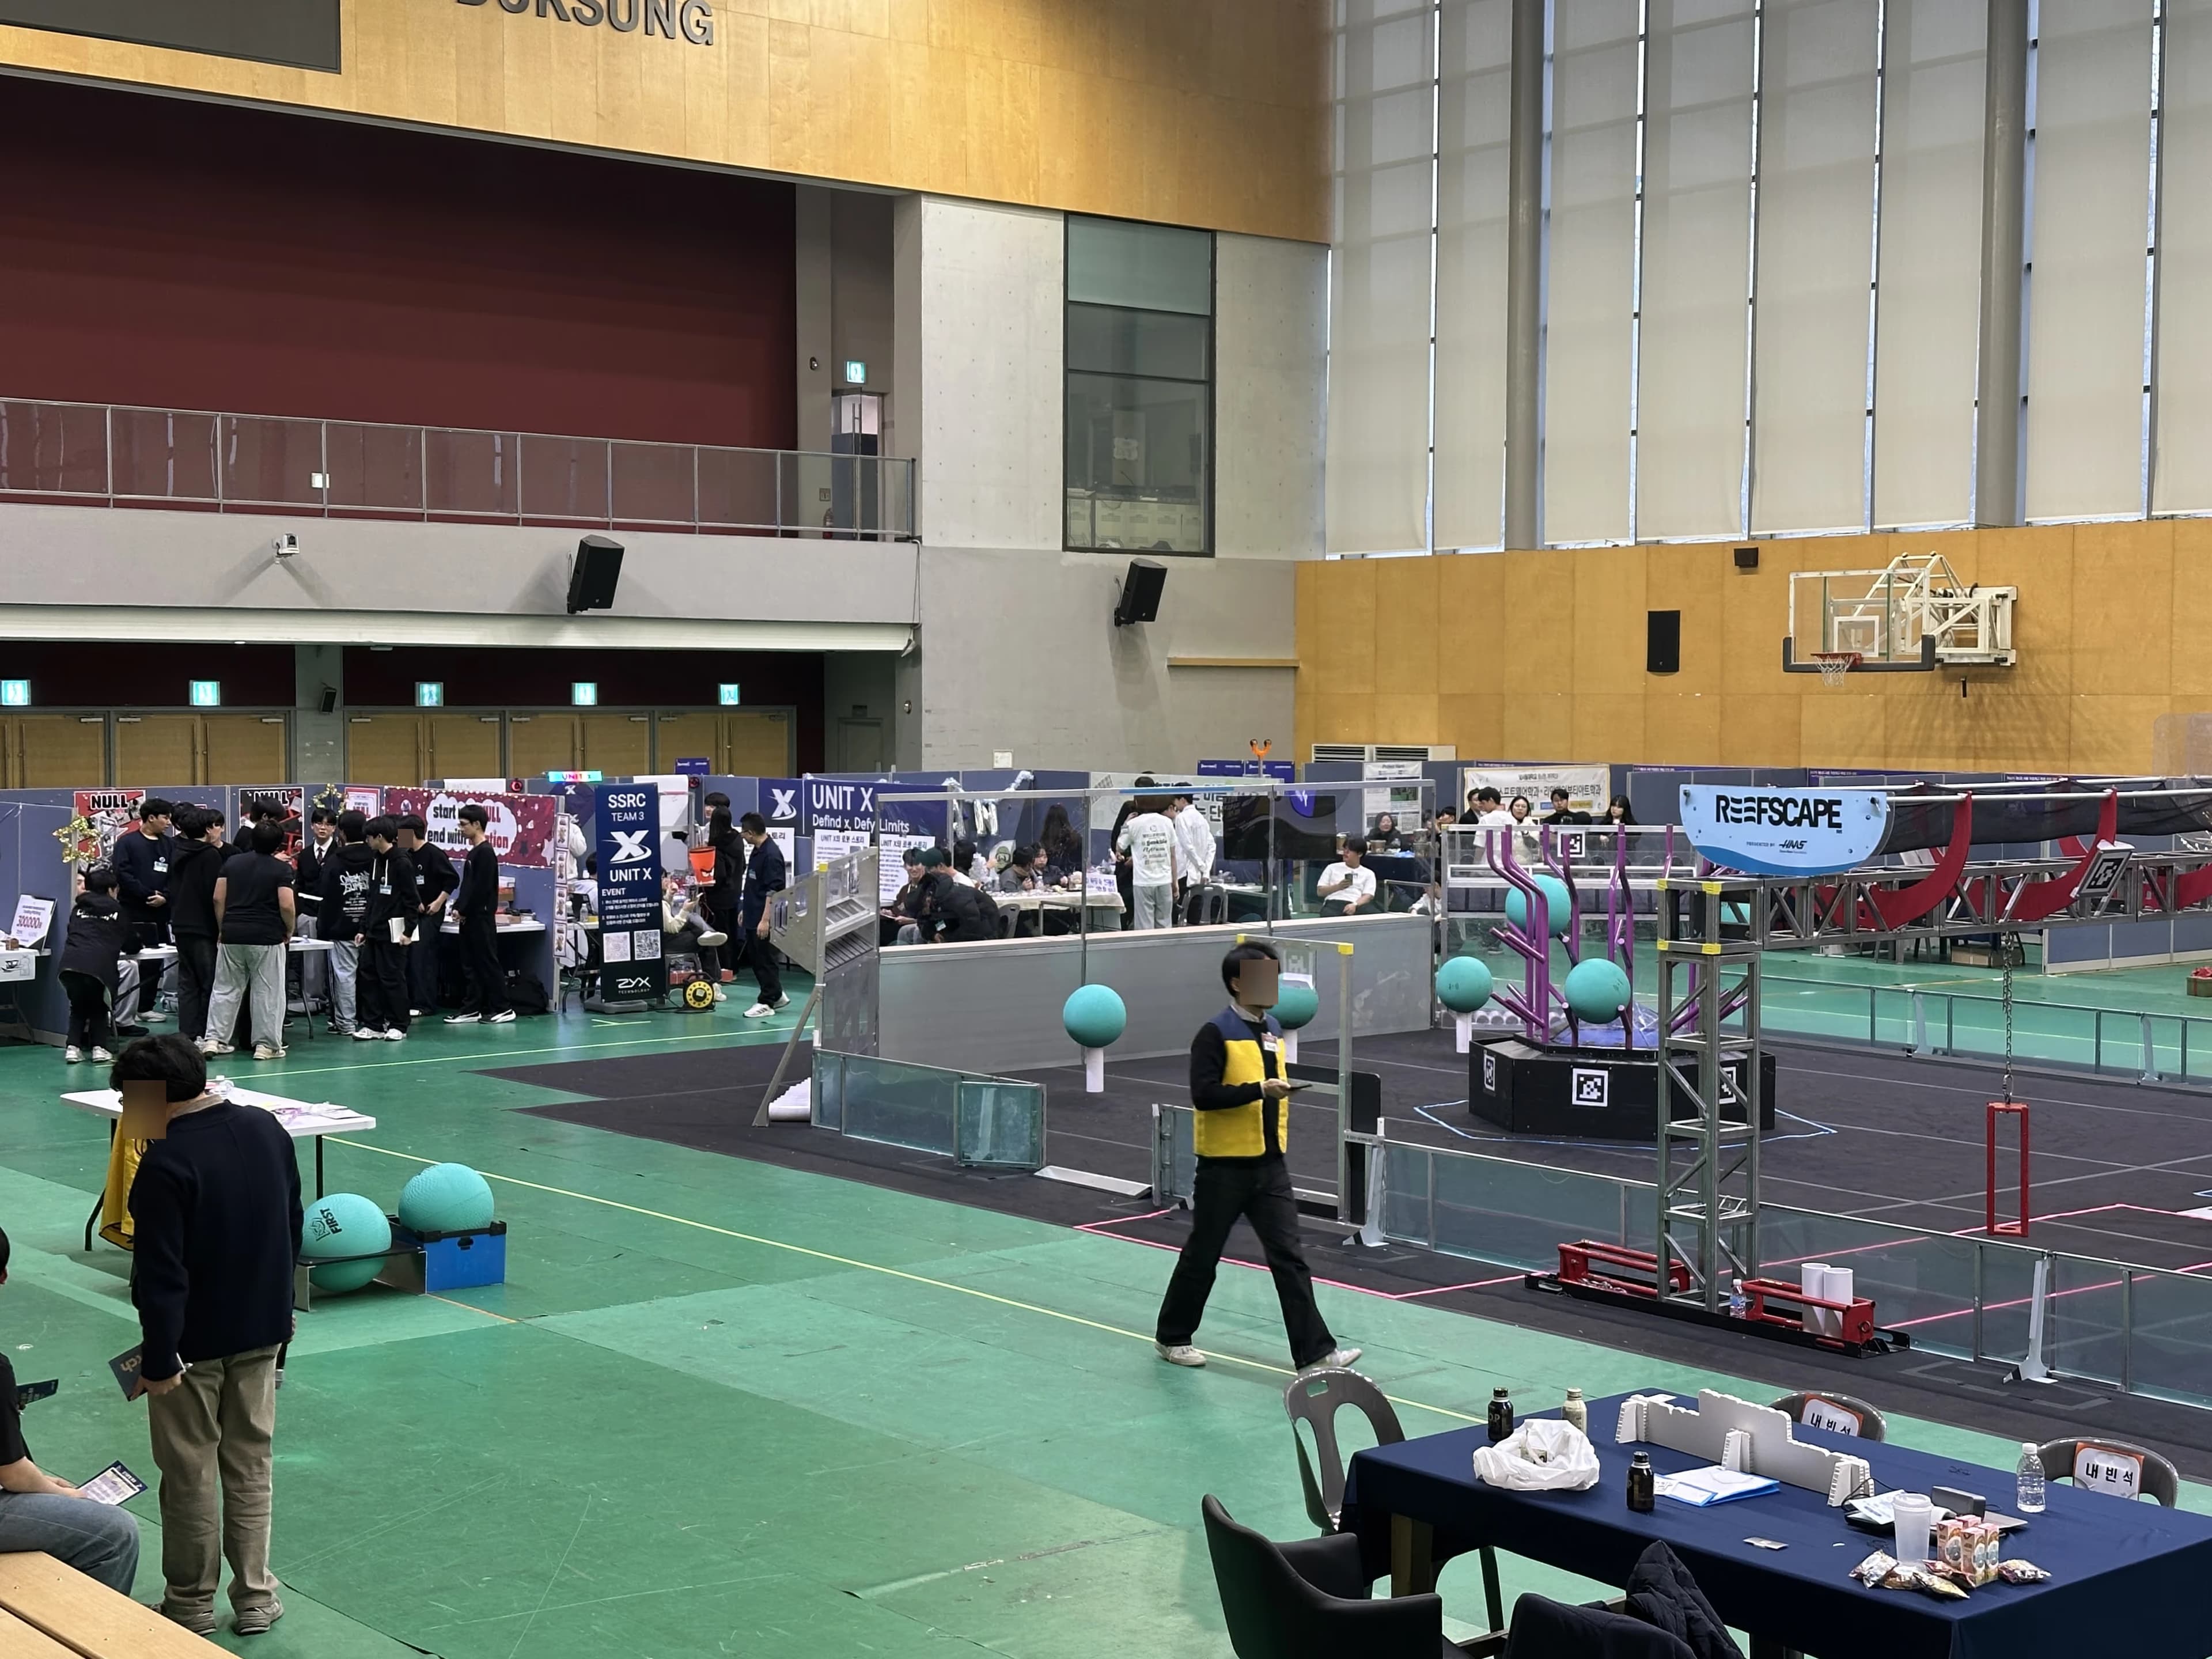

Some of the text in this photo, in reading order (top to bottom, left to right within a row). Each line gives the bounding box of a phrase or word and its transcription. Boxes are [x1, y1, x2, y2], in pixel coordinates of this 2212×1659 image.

[90, 793, 129, 809] NULL
[608, 793, 646, 808] SSRC
[812, 784, 873, 812] UNIT X
[433, 804, 501, 823] start ULL
[611, 812, 645, 821] TEAM 3
[1715, 794, 1842, 829] REEFSCAPE
[813, 813, 841, 828] Defind
[854, 816, 876, 833] Defy
[880, 819, 910, 833] Limits
[427, 827, 445, 843] end
[771, 832, 786, 840] 토리
[609, 868, 652, 882] UNIT X
[601, 887, 627, 896] EVENT
[616, 976, 652, 988] ZYX
[320, 1208, 342, 1234] FIRST
[2086, 1463, 2133, 1487] 내 빈 석
